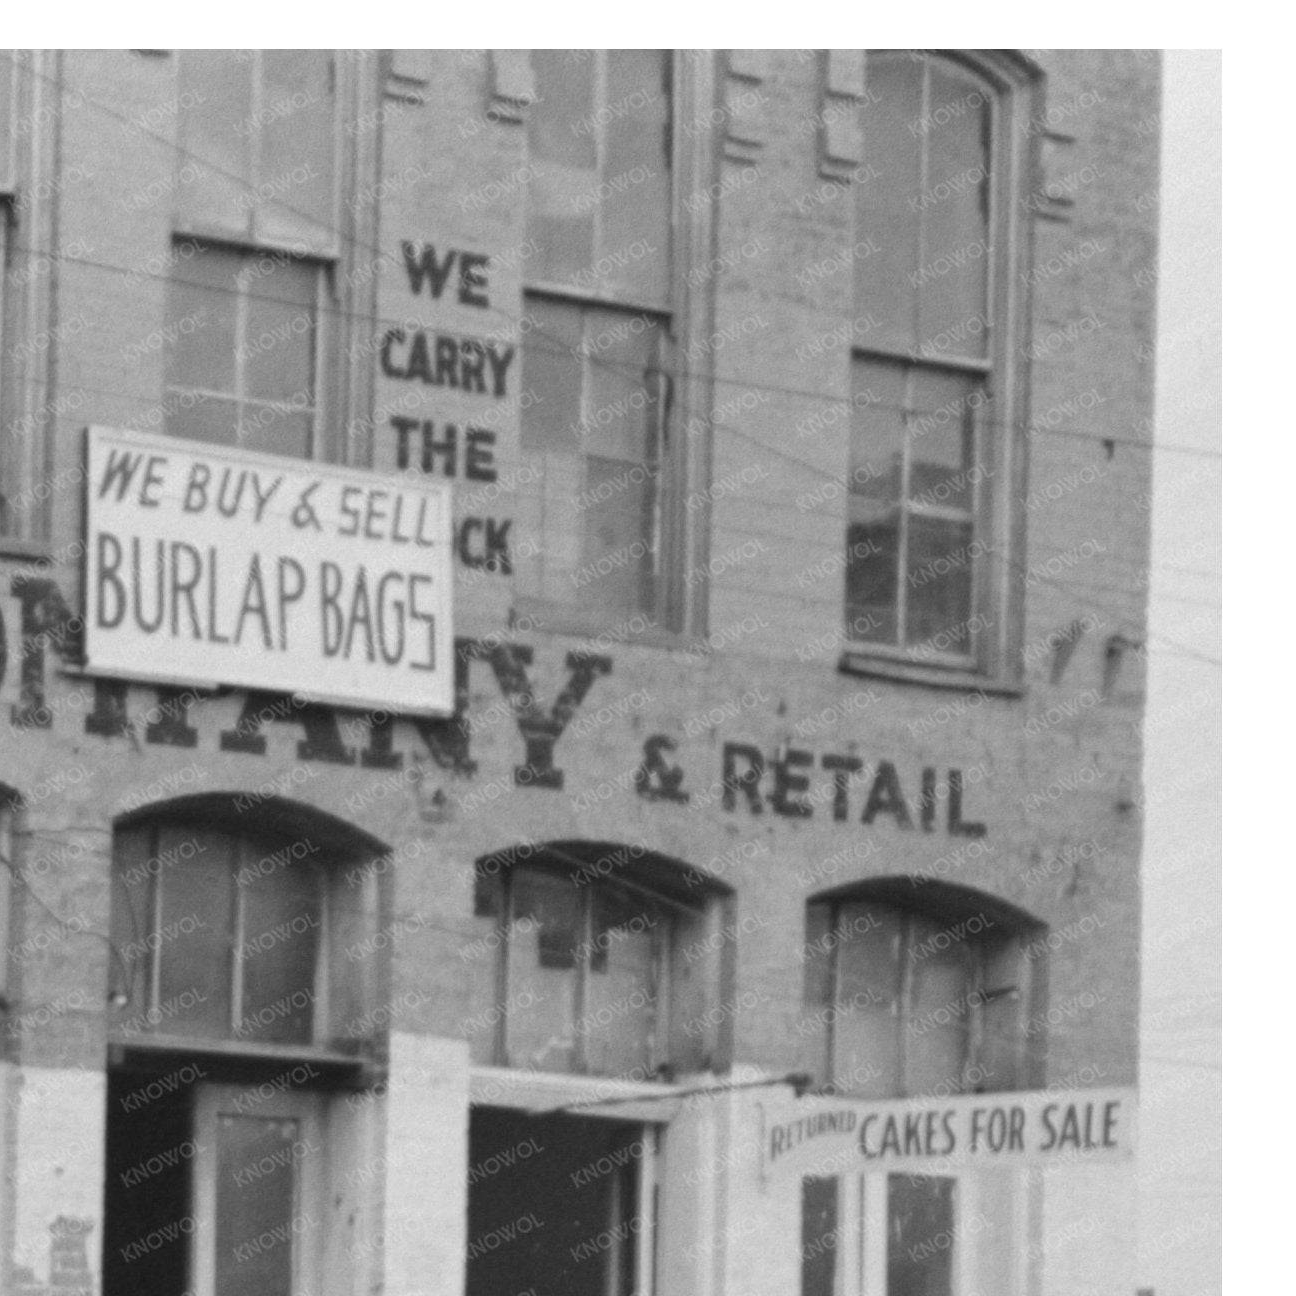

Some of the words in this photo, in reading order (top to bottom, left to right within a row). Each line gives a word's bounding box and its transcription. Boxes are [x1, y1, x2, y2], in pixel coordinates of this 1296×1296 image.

[400, 240, 490, 309] WE
[380, 329, 515, 399] CARRY
[389, 416, 498, 482] THE
[98, 449, 170, 507] WE
[184, 464, 282, 523] BUY
[291, 480, 324, 533] &
[337, 486, 435, 548] SELL
[453, 516, 513, 576] CK
[96, 531, 307, 651] BURLAP
[320, 560, 437, 673] BAGS
[636, 734, 690, 804] &
[722, 742, 988, 839] RETAIL
[770, 1108, 857, 1161] RETURNED
[860, 1110, 956, 1159] CAKES
[969, 1106, 1026, 1153] FOR
[1039, 1101, 1121, 1151] SALE
